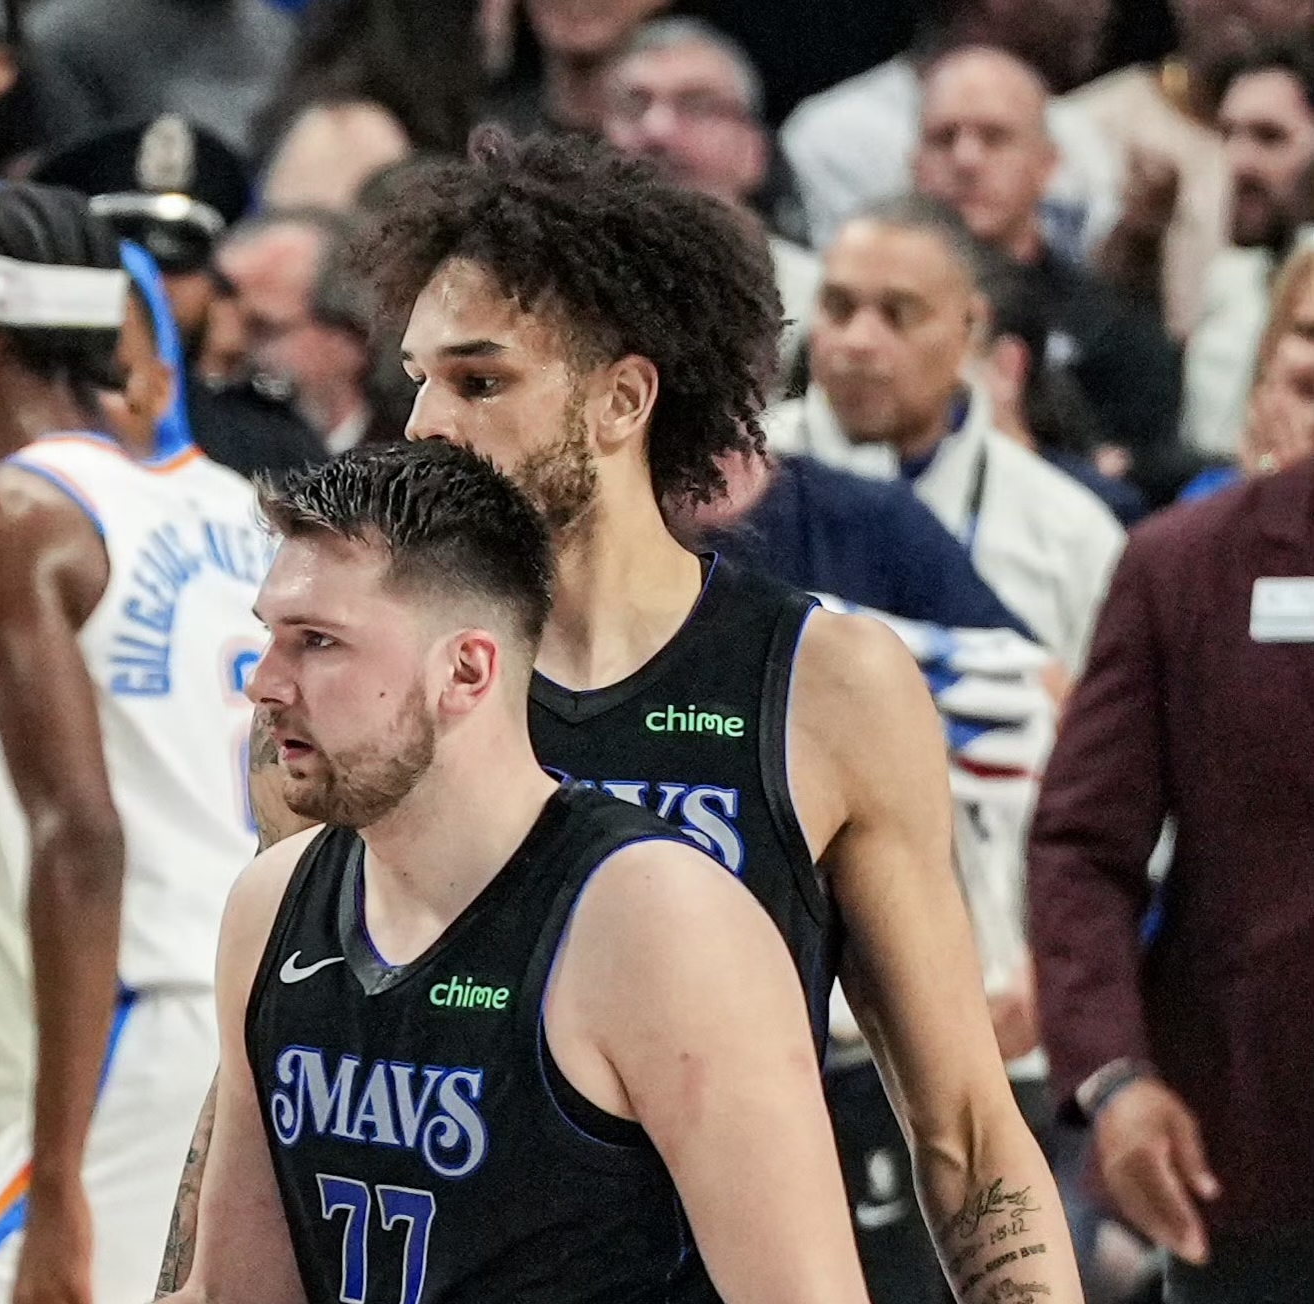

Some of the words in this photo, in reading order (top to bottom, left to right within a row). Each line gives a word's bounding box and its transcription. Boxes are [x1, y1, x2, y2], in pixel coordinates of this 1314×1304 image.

[645, 704, 745, 737] chime
[429, 975, 509, 1009] chime
[271, 1045, 488, 1178] MAVS
